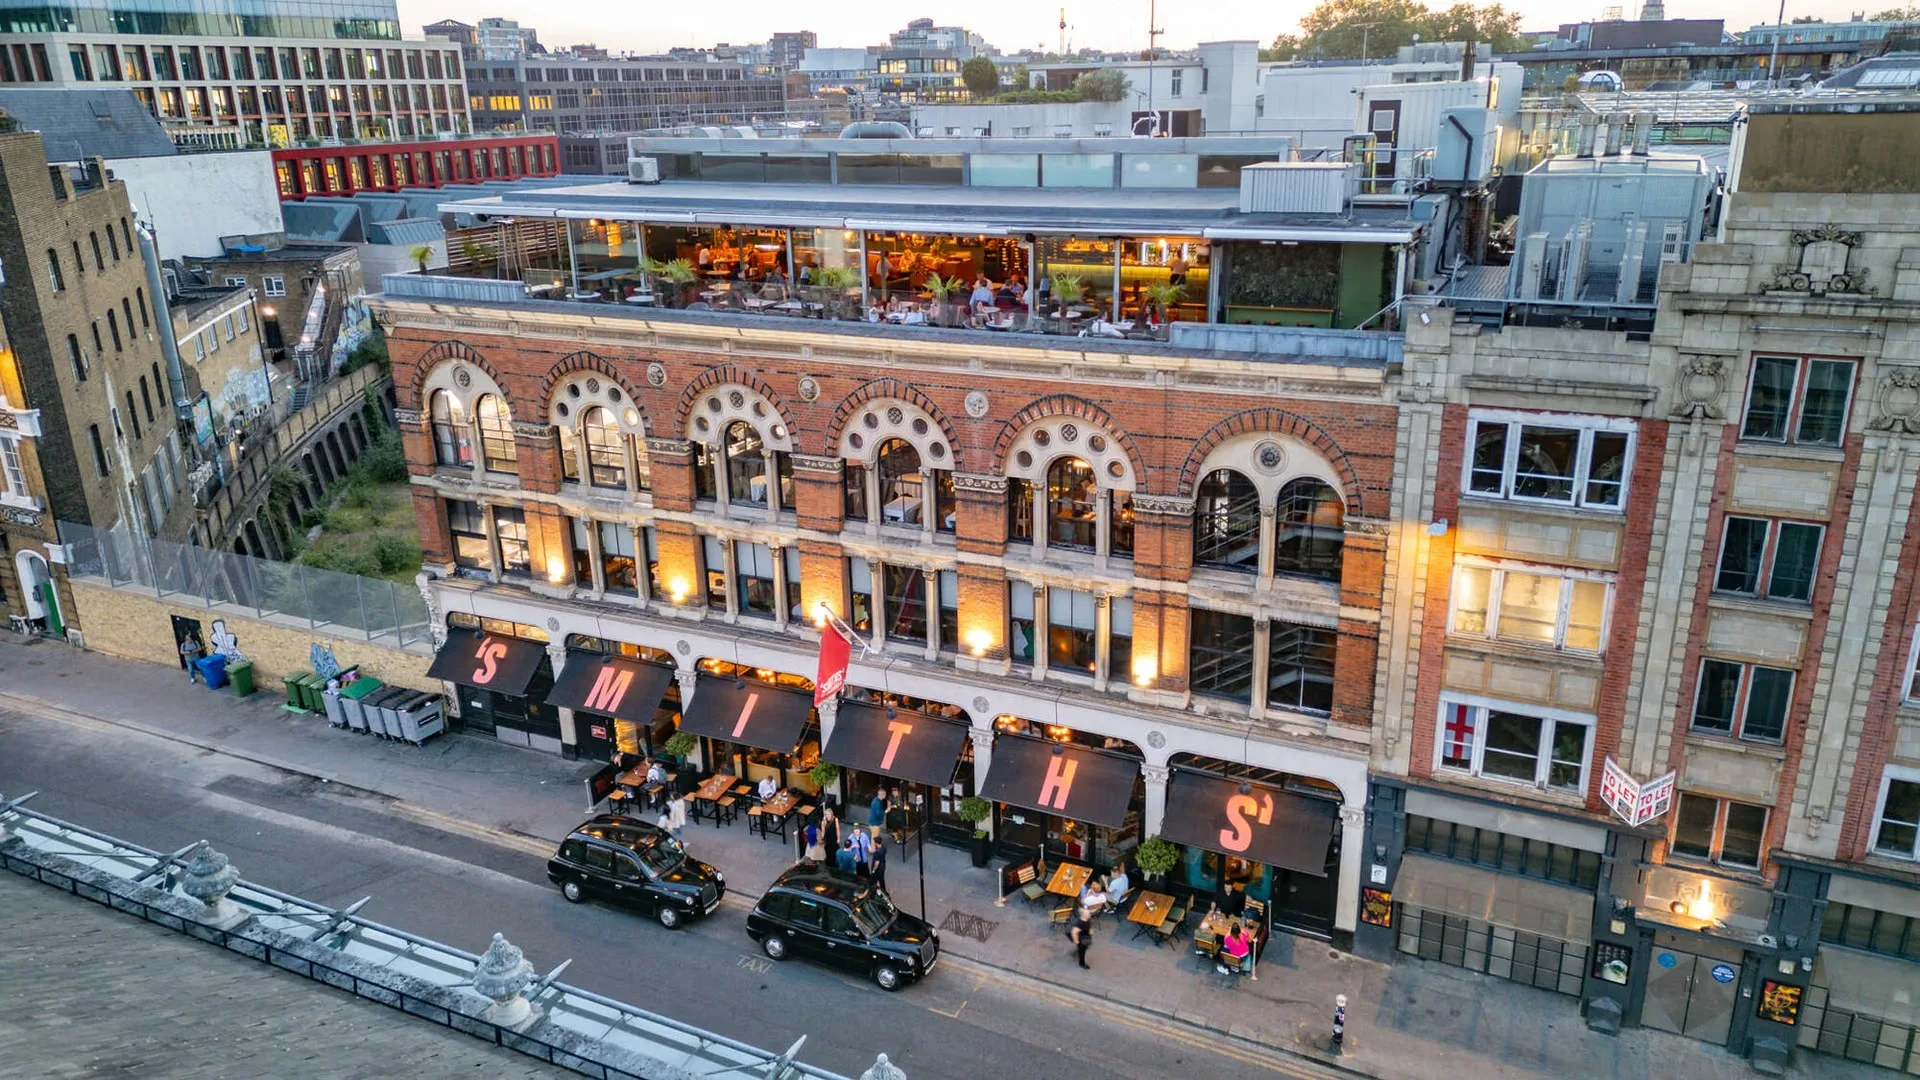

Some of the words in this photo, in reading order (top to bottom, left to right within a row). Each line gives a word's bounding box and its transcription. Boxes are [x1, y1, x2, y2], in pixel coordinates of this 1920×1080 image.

[584, 666, 634, 712] M
[880, 721, 913, 770] T
[1037, 756, 1078, 810] H
[1605, 770, 1616, 787] TO
[1617, 783, 1637, 805] LET
[1640, 793, 1653, 807] TO
[1655, 783, 1673, 800] LET
[736, 953, 773, 975] TAXI
